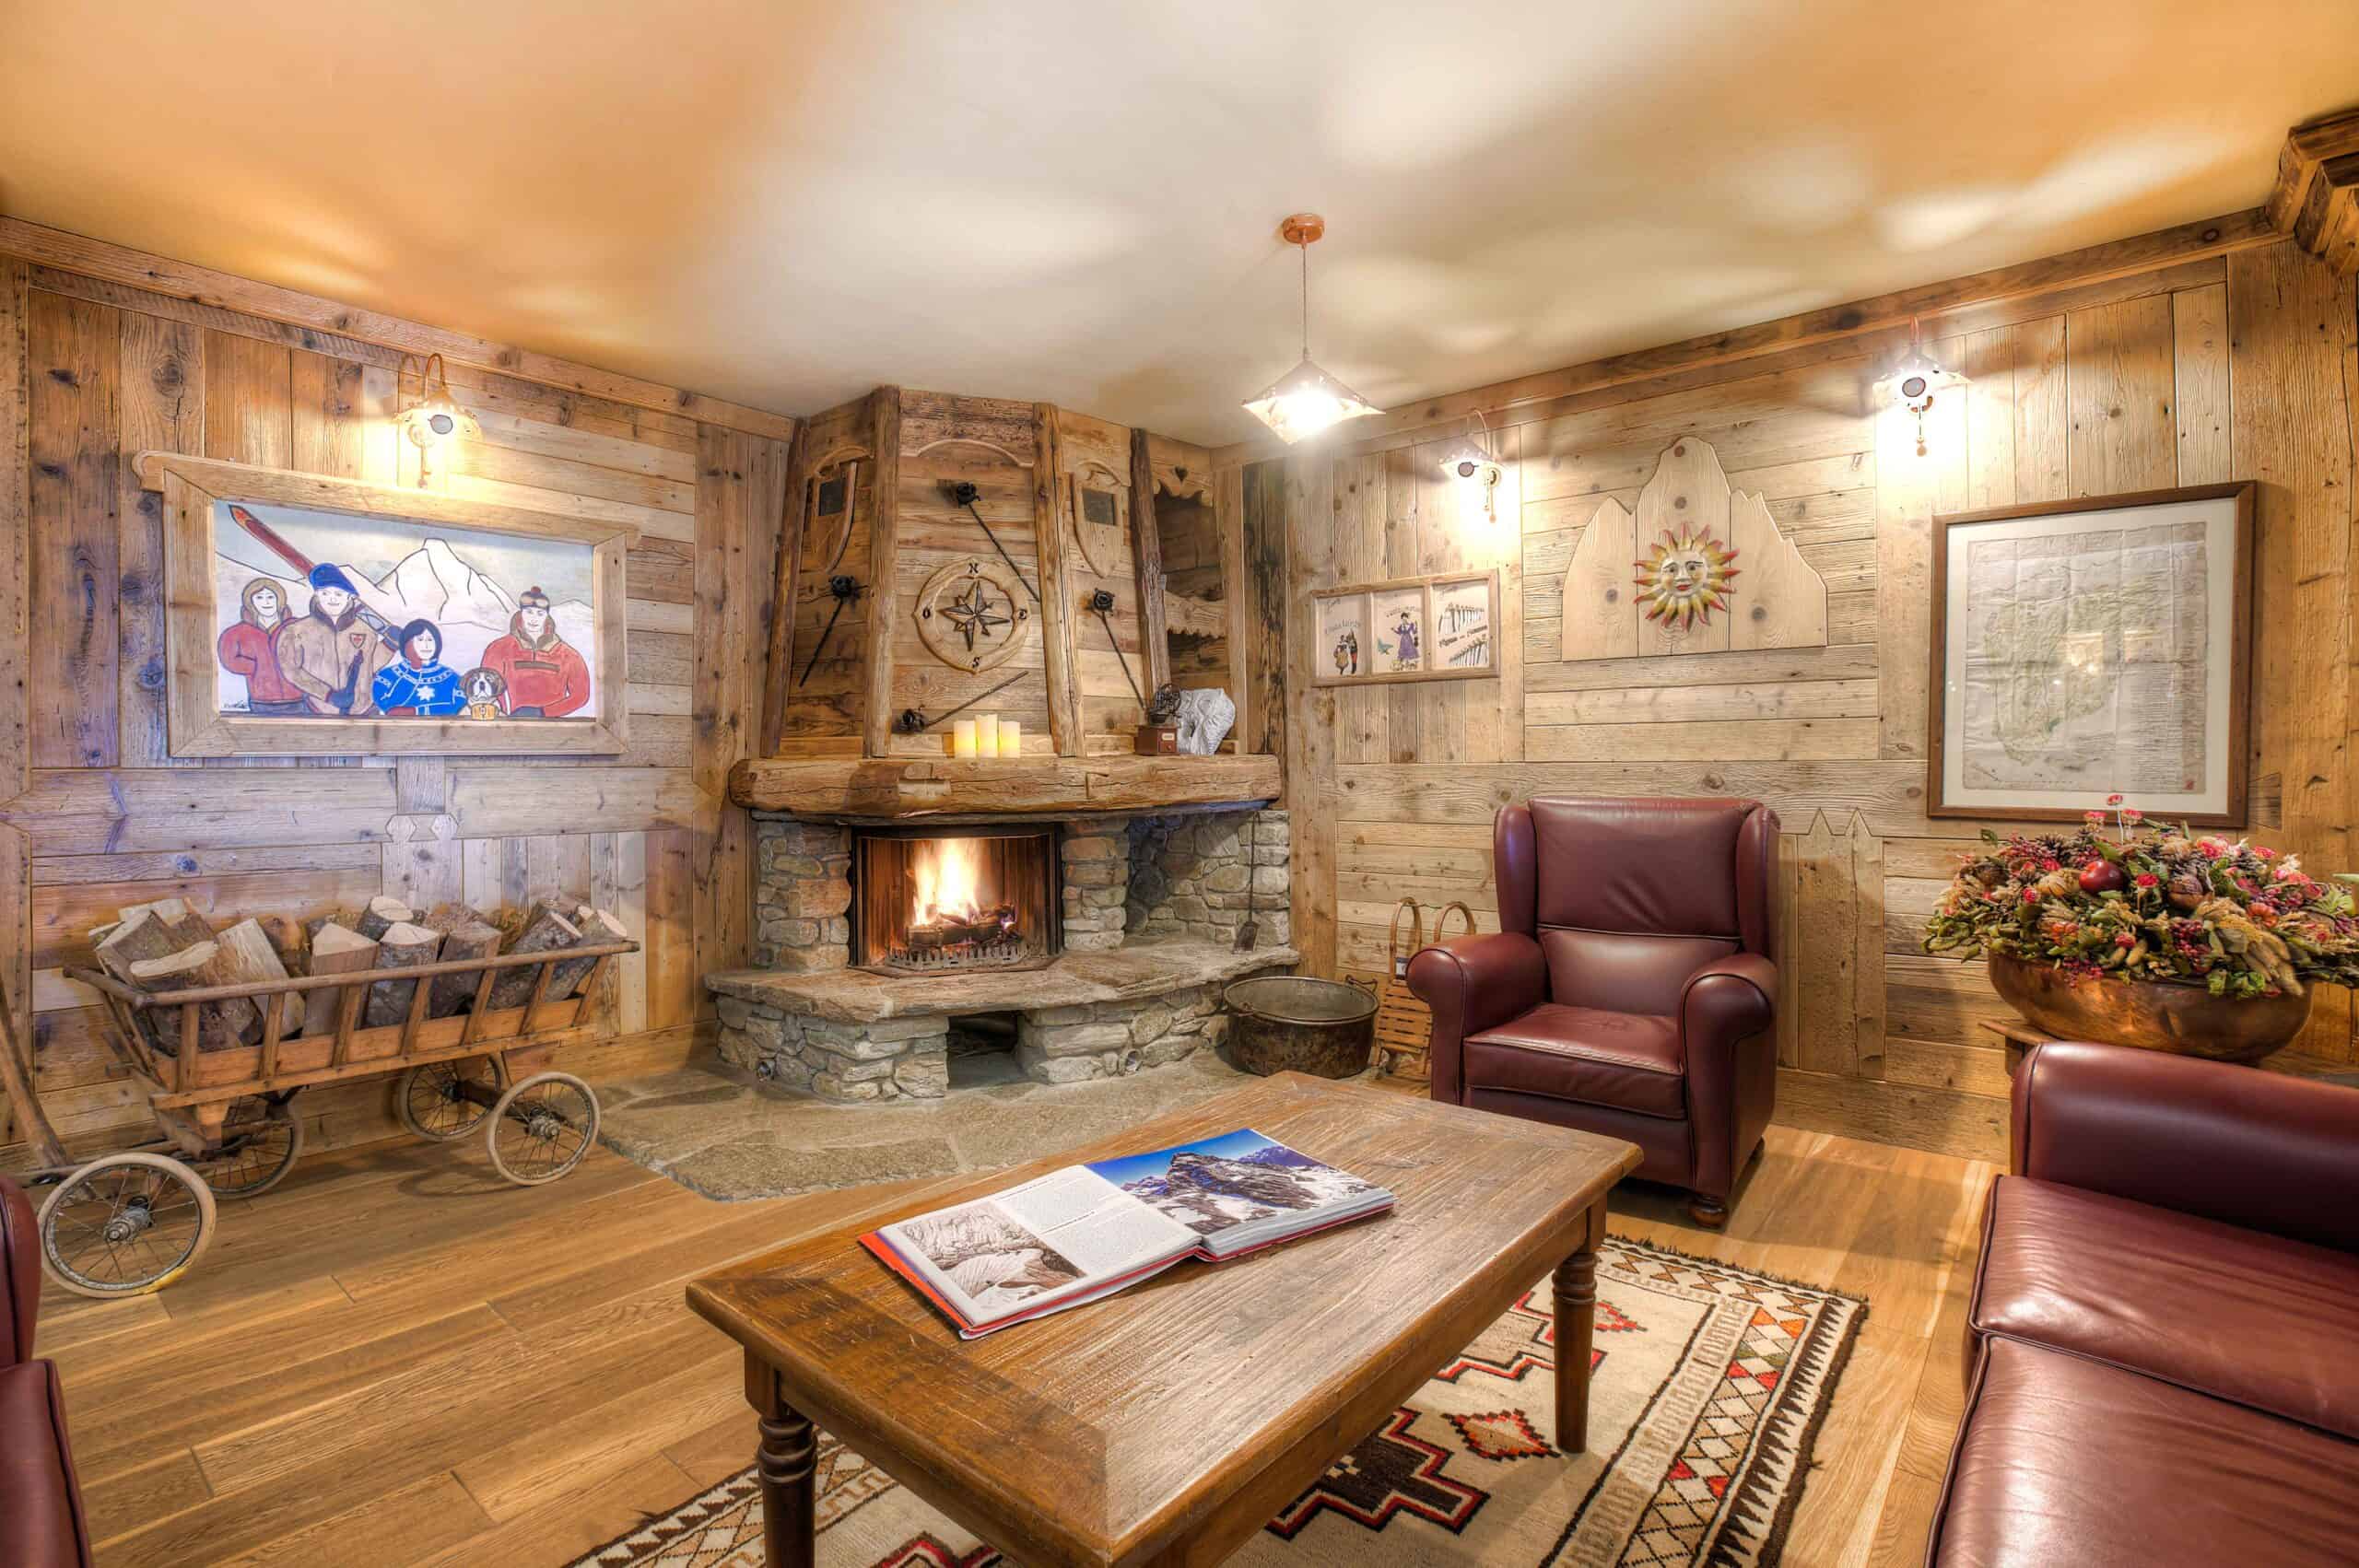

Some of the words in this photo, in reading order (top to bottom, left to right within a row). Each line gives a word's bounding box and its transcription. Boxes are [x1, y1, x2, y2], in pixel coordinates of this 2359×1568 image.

[968, 563, 979, 574] N
[922, 608, 932, 619] O
[1018, 609, 1028, 620] E
[972, 656, 981, 669] S
